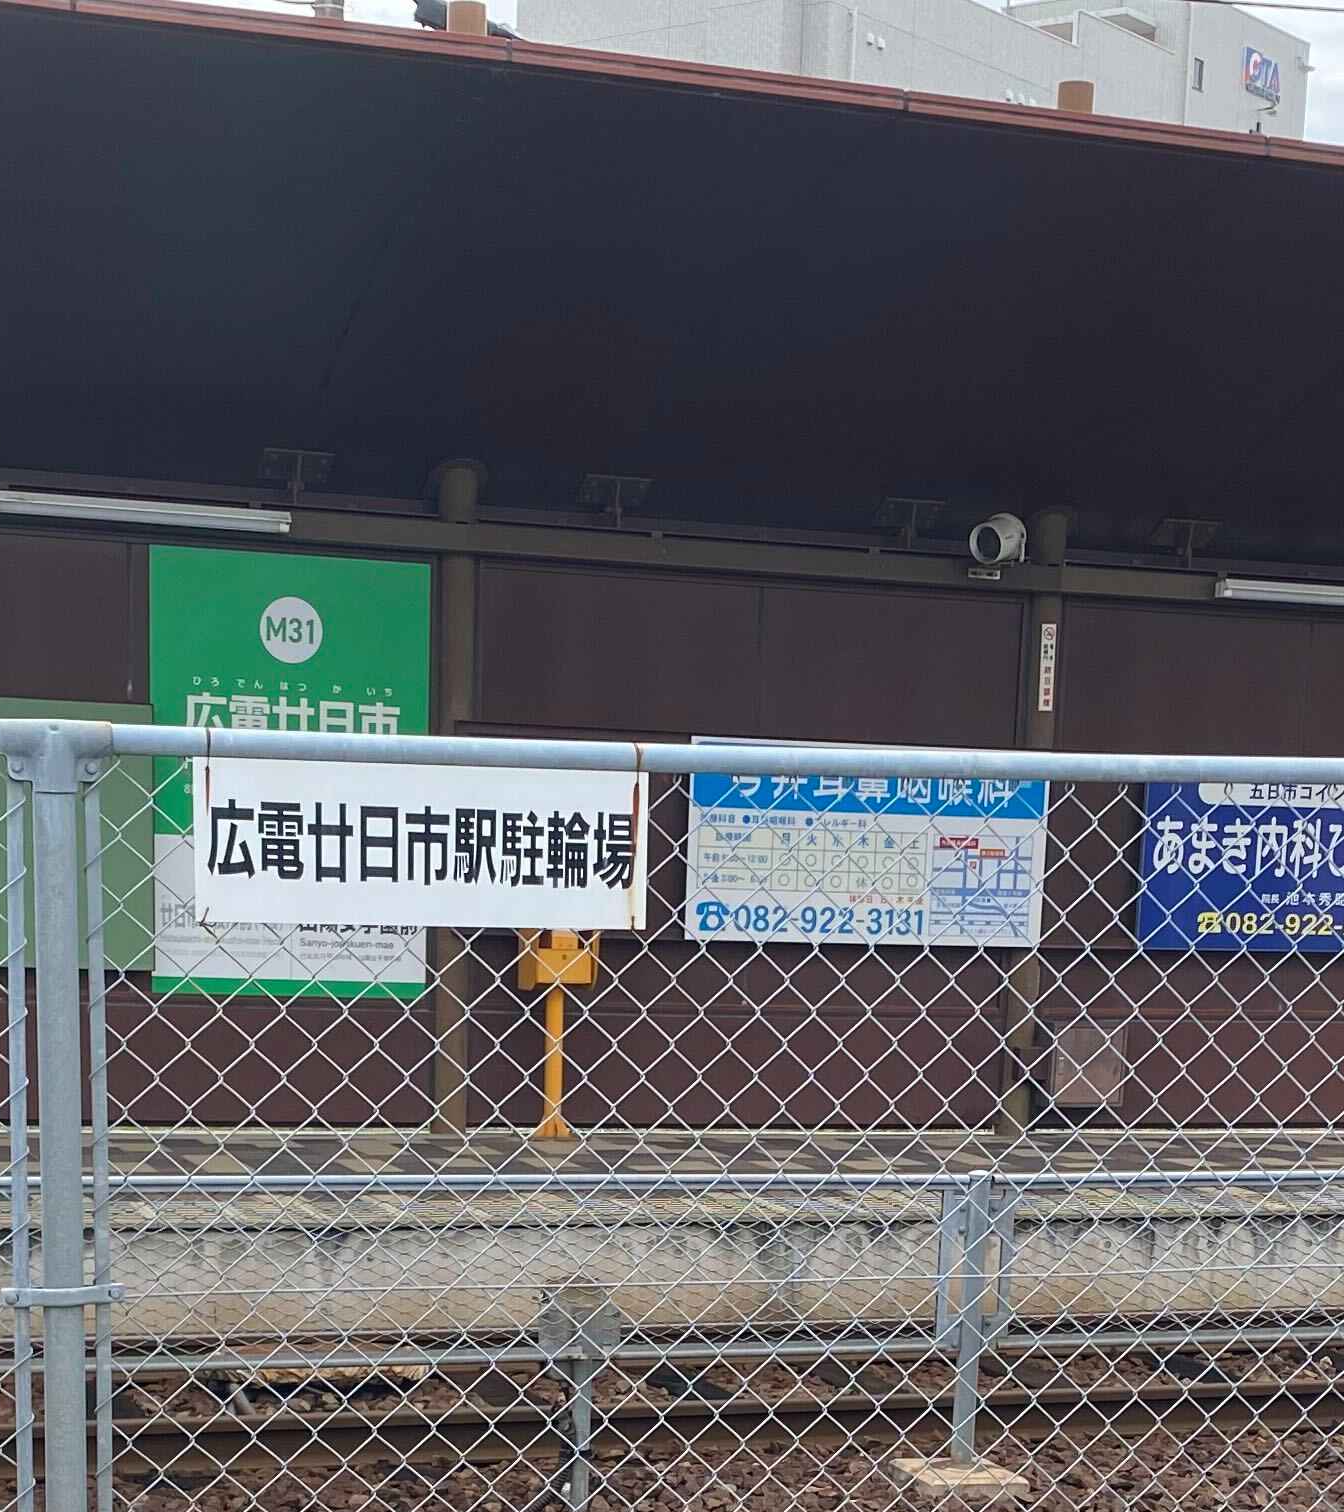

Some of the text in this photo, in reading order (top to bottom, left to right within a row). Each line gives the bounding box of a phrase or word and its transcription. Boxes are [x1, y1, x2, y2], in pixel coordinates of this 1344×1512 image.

[266, 616, 315, 644] M31
[207, 798, 635, 890] 広電廿日市駅駐輪場
[807, 835, 818, 847] 火
[858, 836, 870, 849] 木
[884, 837, 896, 849] 金
[735, 904, 924, 936] 082-922-3131
